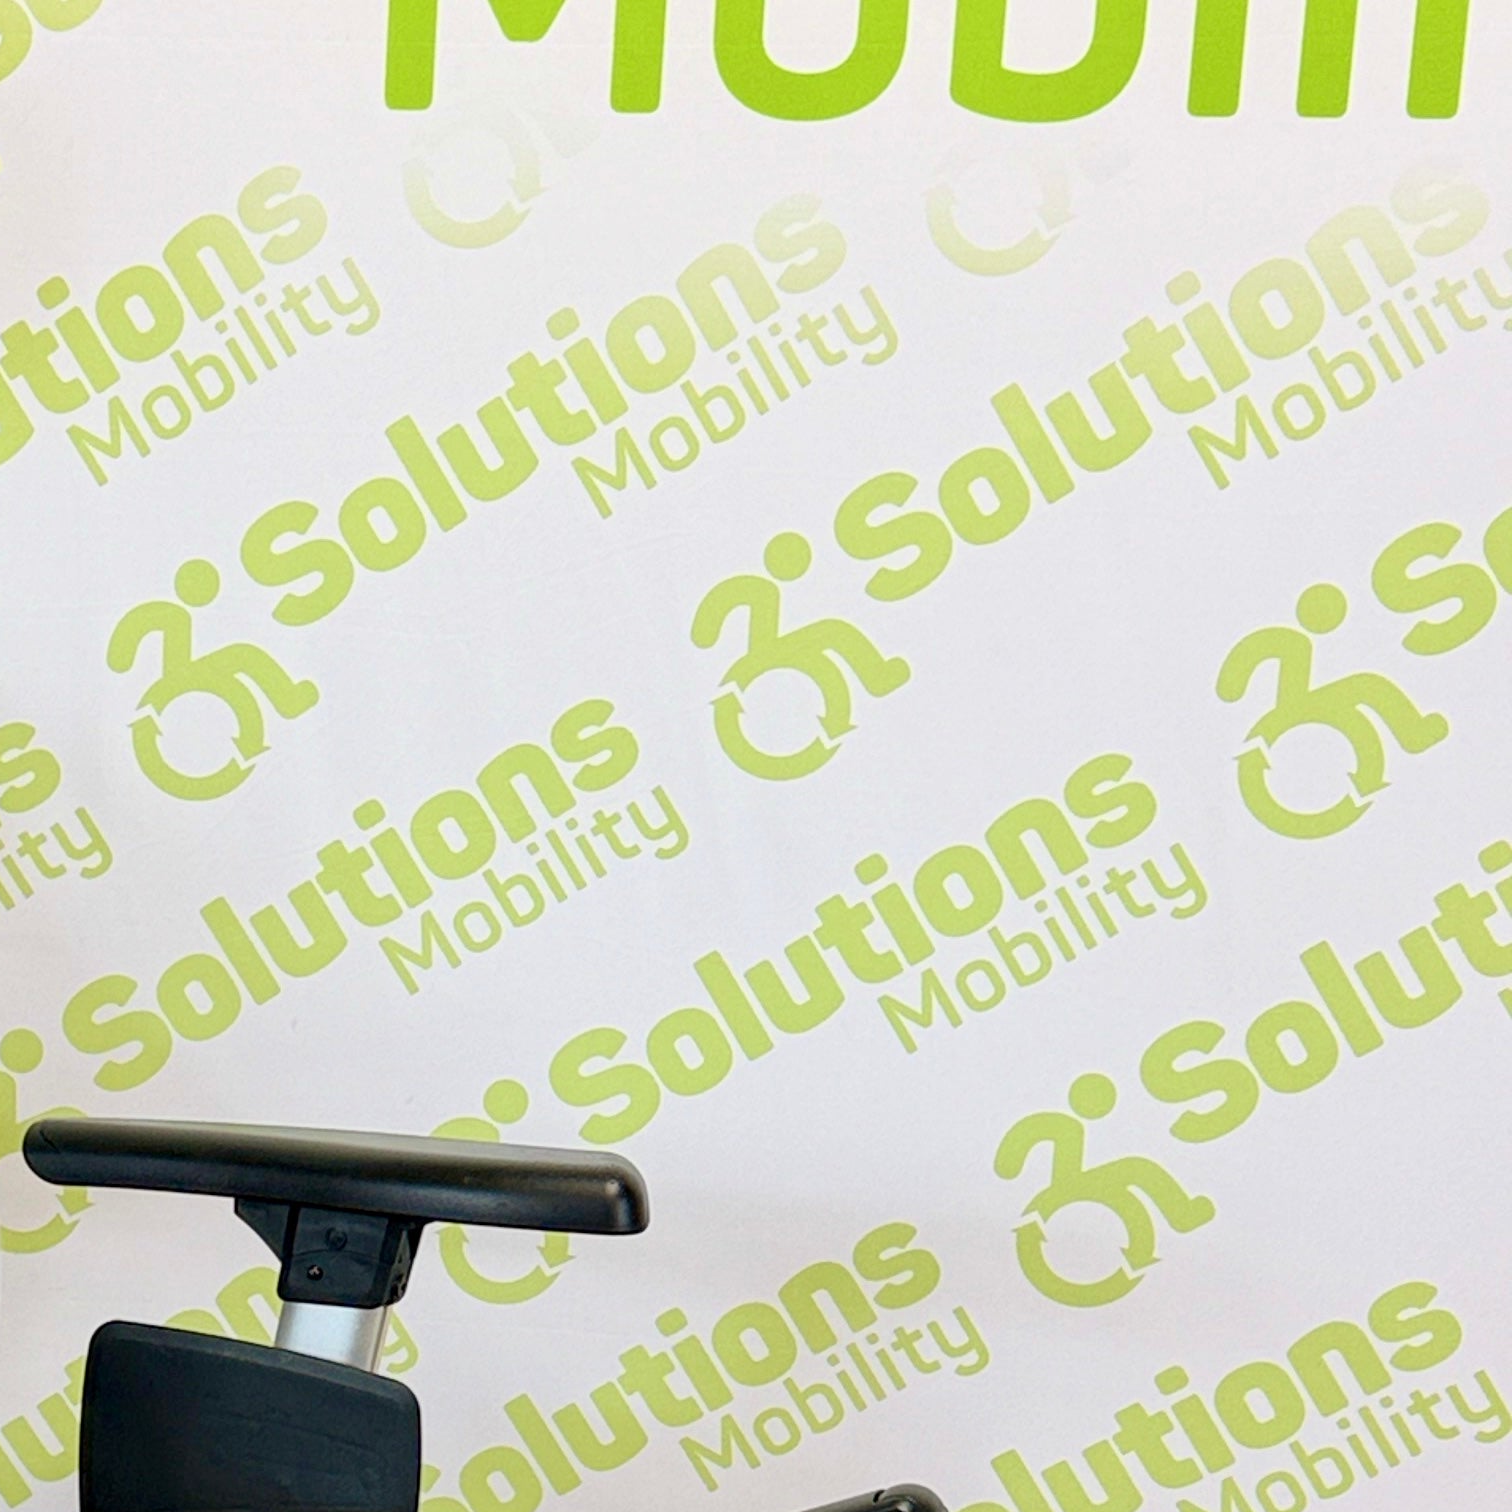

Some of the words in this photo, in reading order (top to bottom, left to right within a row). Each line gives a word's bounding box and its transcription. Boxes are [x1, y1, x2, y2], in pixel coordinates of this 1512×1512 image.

[65, 256, 381, 487] Mobility
[240, 192, 847, 627] Solutions
[571, 284, 899, 520] Mobility
[833, 163, 1490, 602] Solutions
[61, 698, 640, 1093] Solutions
[379, 786, 691, 996] Mobility
[548, 752, 1159, 1146] Solutions
[877, 842, 1210, 1055] Mobility
[679, 1306, 992, 1493] Mobility
